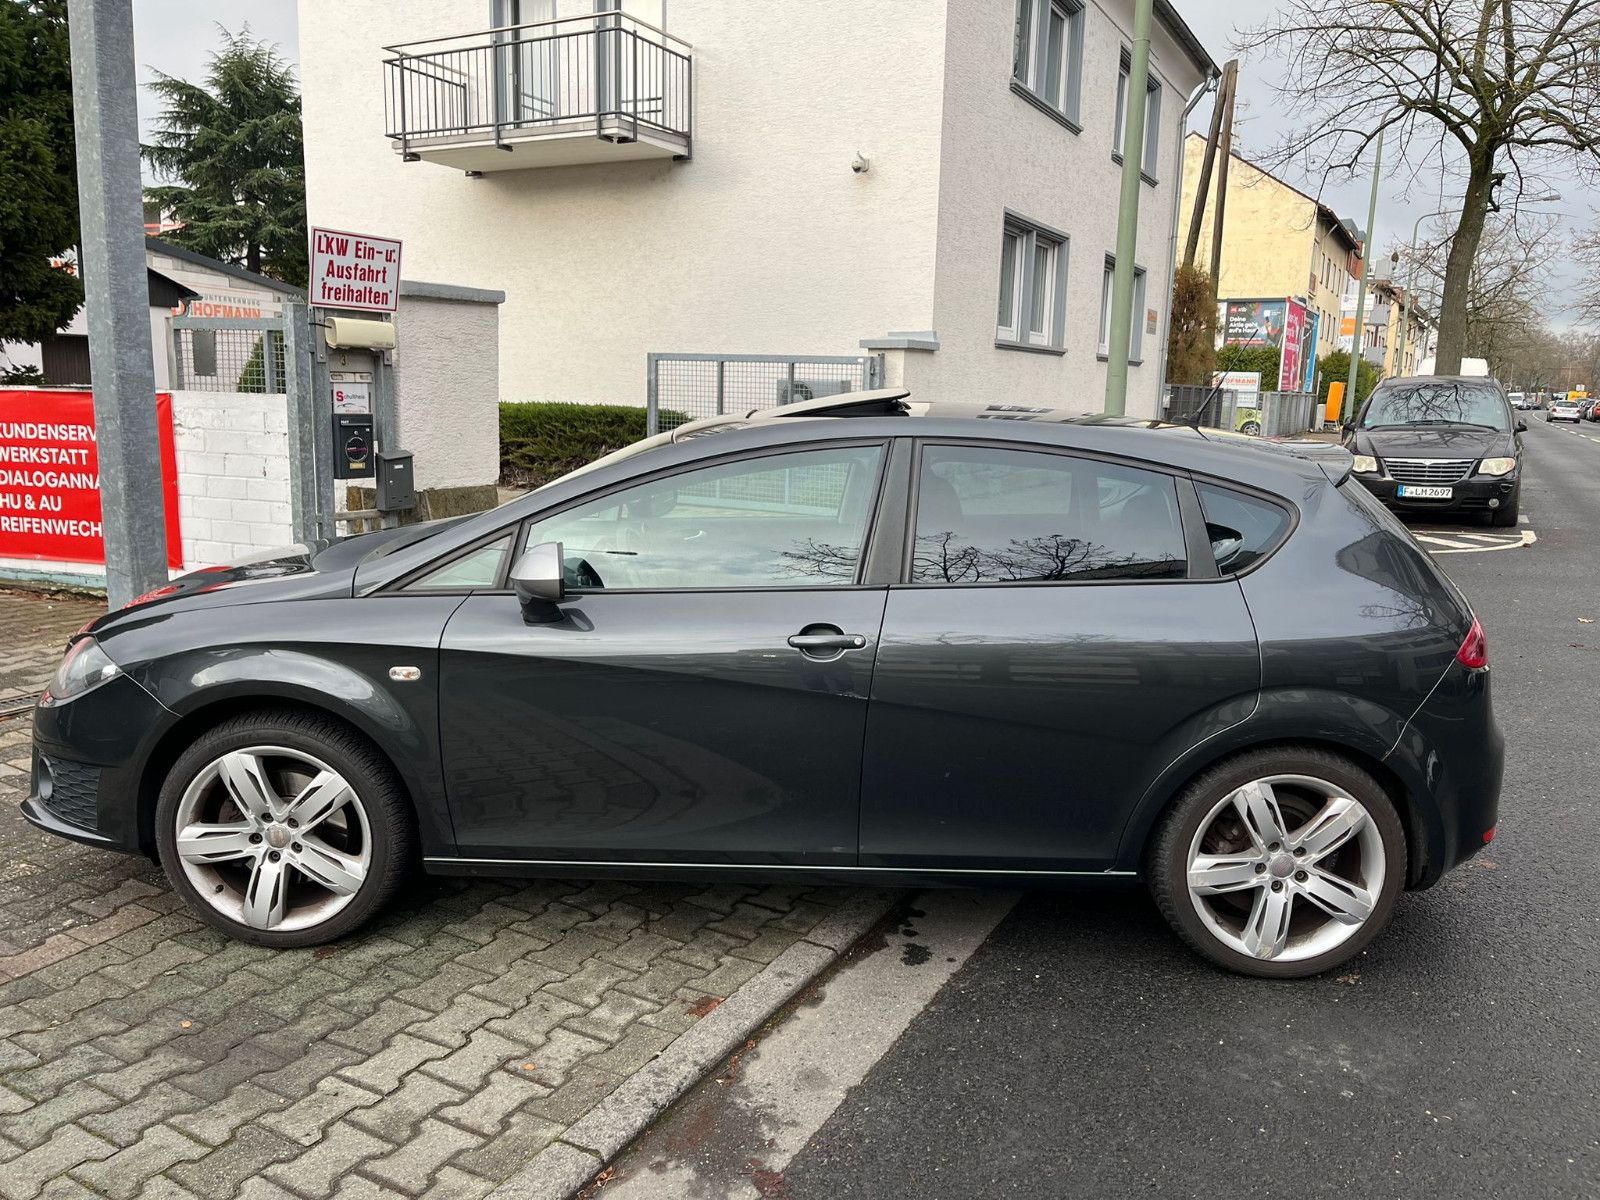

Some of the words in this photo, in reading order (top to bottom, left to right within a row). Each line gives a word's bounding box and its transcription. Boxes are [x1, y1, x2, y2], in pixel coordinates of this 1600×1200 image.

[317, 234, 349, 257] LKW
[325, 259, 387, 284] Ausfahrt
[321, 281, 389, 305] freihalten
[192, 302, 261, 320] HOFMANN
[0, 493, 21, 510] HU
[24, 493, 36, 511] &
[39, 494, 62, 512] AU
